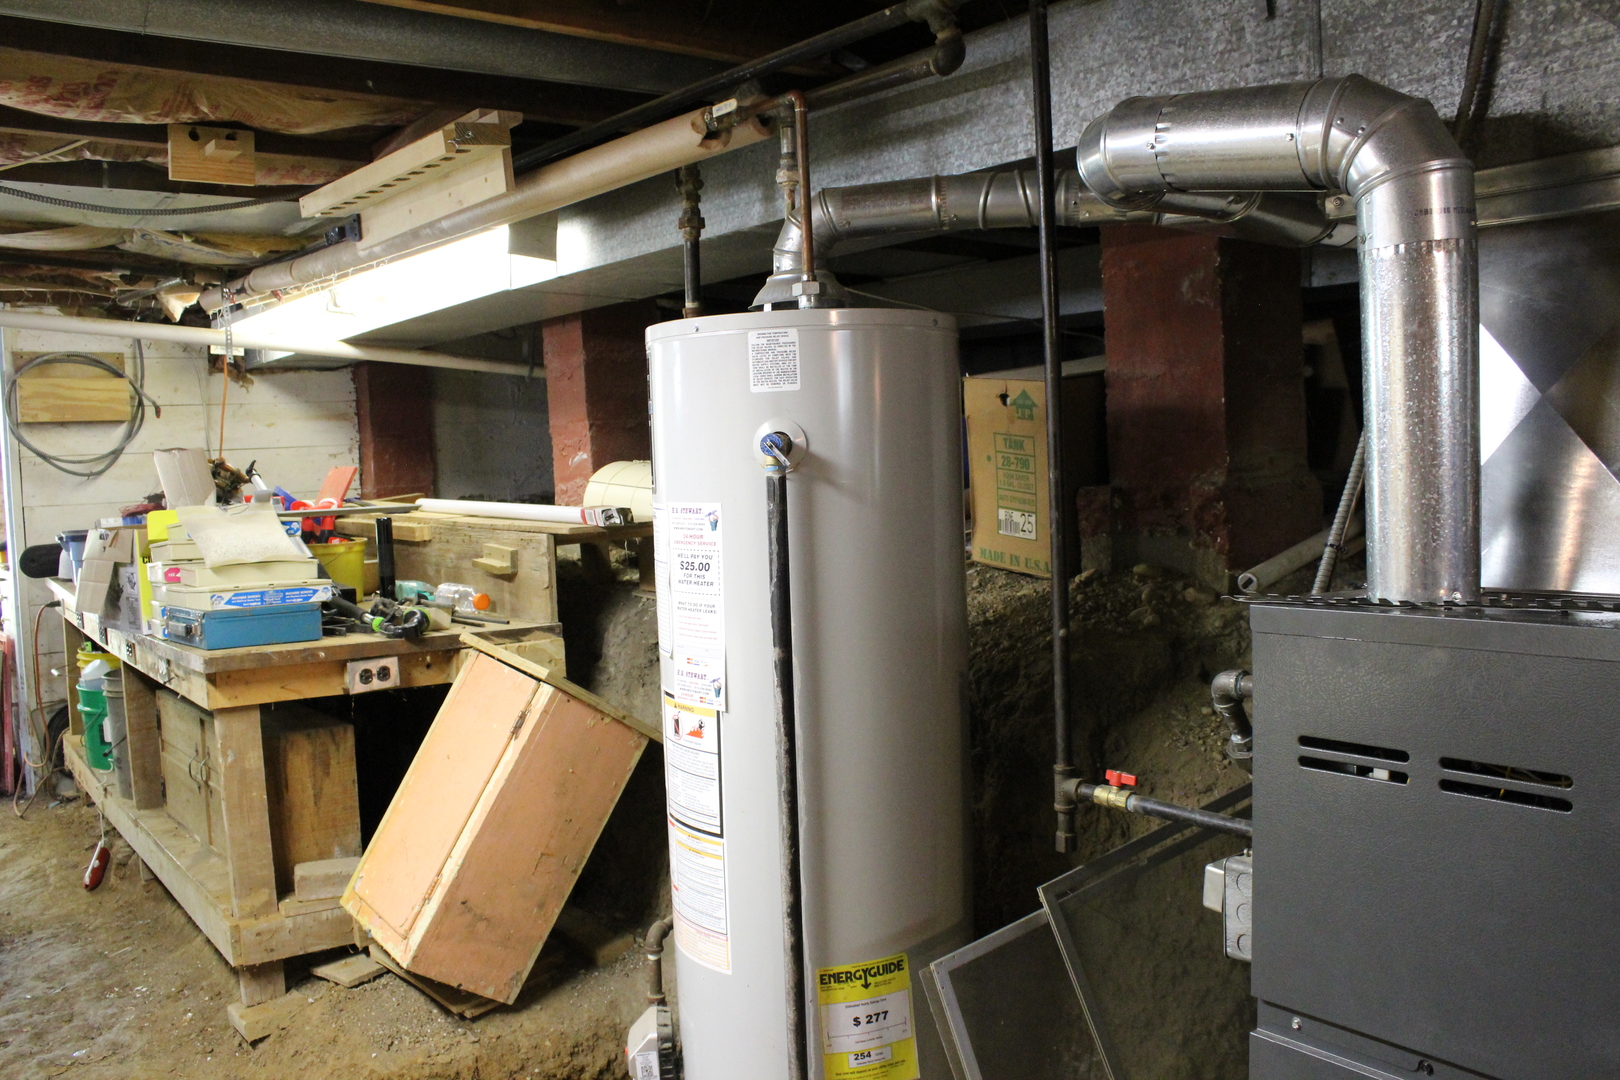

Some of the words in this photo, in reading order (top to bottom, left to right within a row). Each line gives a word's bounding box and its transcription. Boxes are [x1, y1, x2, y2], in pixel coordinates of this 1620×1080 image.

[1003, 437, 1025, 451] TANK
[1001, 455, 1030, 470] 28-790
[1020, 513, 1034, 533] 25
[980, 547, 1006, 564] MADE
[1010, 554, 1020, 567] IN
[680, 560, 710, 572] $25.00
[820, 959, 905, 988] ENERGYGUIDE
[853, 1016, 861, 1028] $
[866, 1010, 888, 1024] 277
[854, 1051, 872, 1060] 254
